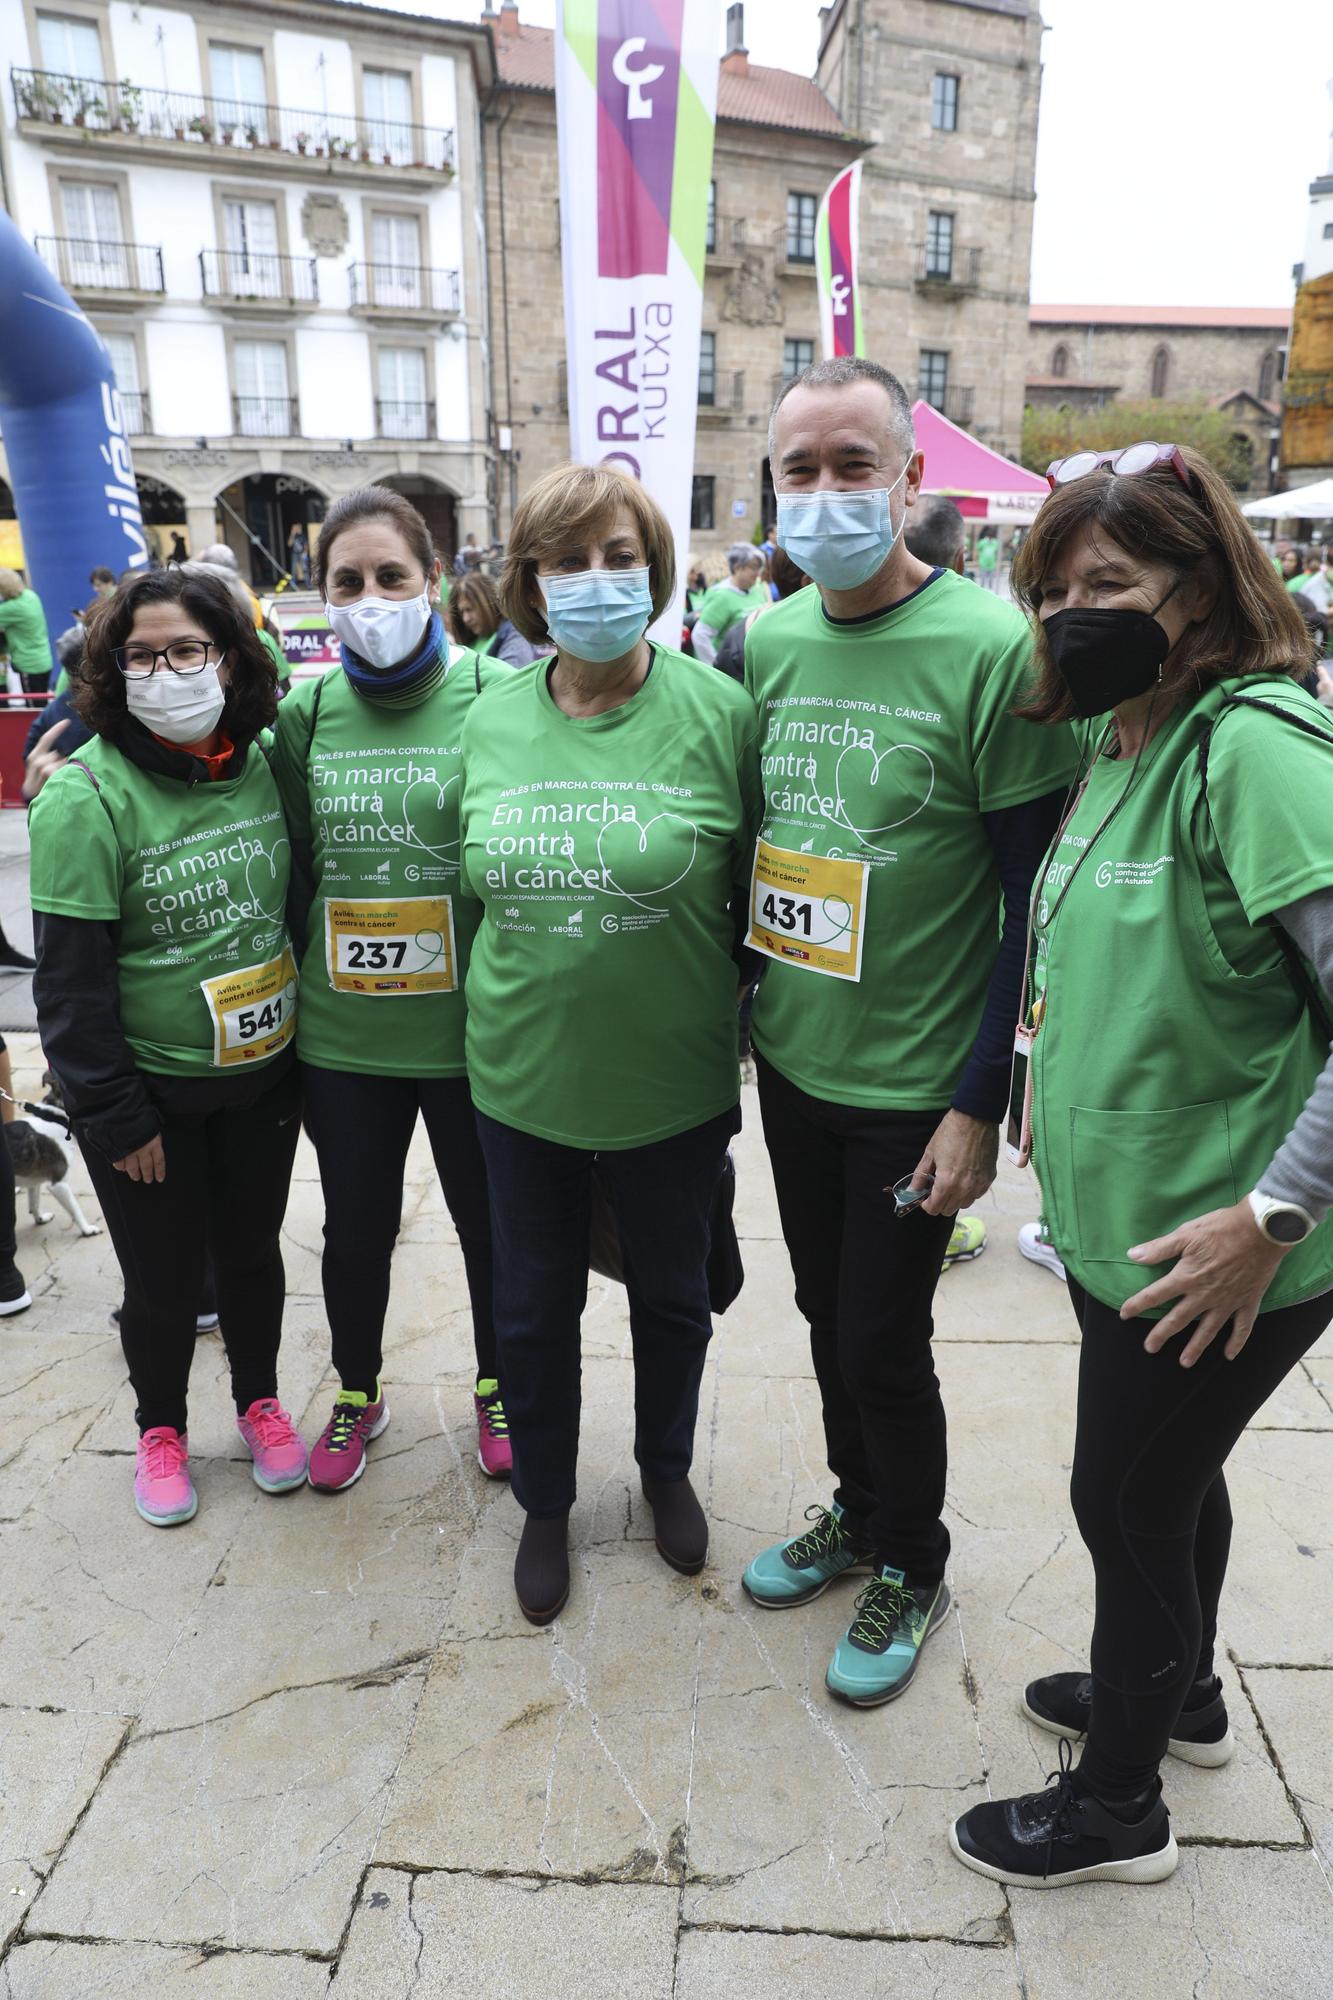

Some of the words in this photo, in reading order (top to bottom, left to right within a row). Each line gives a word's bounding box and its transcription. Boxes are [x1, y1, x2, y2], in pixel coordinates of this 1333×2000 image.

[100, 381, 149, 568] vilés
[788, 697, 799, 706] EN
[800, 697, 833, 707] MARCHA
[836, 699, 876, 713] CONTRA
[879, 705, 892, 715] EL
[895, 706, 941, 723] CÁNCER
[767, 717, 780, 743] En
[784, 718, 875, 750] marcha
[315, 751, 343, 761] AVILÉS
[359, 748, 396, 757] MARCHA
[399, 747, 435, 755] CONTRA
[761, 753, 817, 779] contra
[313, 765, 338, 786] En
[345, 760, 437, 785] marcha
[500, 785, 529, 798] AVILÉS
[531, 783, 543, 792] EN
[544, 781, 588, 790] MARCHA
[590, 781, 634, 791] CONTRA
[636, 782, 649, 791] EL
[652, 782, 693, 798] CÁNCER
[770, 785, 845, 818] cáncer
[314, 791, 383, 815] contra
[491, 804, 523, 826] En
[531, 797, 636, 824] marcha
[140, 843, 170, 857] AVILÉS
[172, 839, 182, 850] EN
[183, 828, 223, 844] MARCHA
[224, 818, 254, 833] CONTRA
[254, 817, 263, 825] EL
[319, 819, 330, 843] el
[332, 818, 415, 842] cáncer
[485, 832, 575, 856] contra
[142, 864, 173, 887] En
[179, 836, 264, 877] marcha
[779, 862, 810, 874] marcha
[1116, 861, 1153, 869] asociación
[485, 861, 507, 889] el
[514, 862, 612, 889] cáncer
[772, 870, 778, 878] el
[780, 873, 806, 884] cáncer
[145, 878, 229, 913] contra
[151, 916, 174, 935] el
[181, 898, 260, 932] cáncer
[333, 910, 354, 918] Avilés
[367, 920, 396, 928] cáncer
[505, 907, 519, 919] edp
[762, 893, 812, 936] 431
[496, 921, 536, 933] fundación
[209, 950, 239, 960] LABORAL
[348, 941, 408, 969] 237
[217, 983, 241, 996] Avilés
[219, 993, 245, 1005] contra
[247, 988, 255, 997] el
[256, 980, 277, 994] cáncer
[238, 998, 282, 1039] 541
